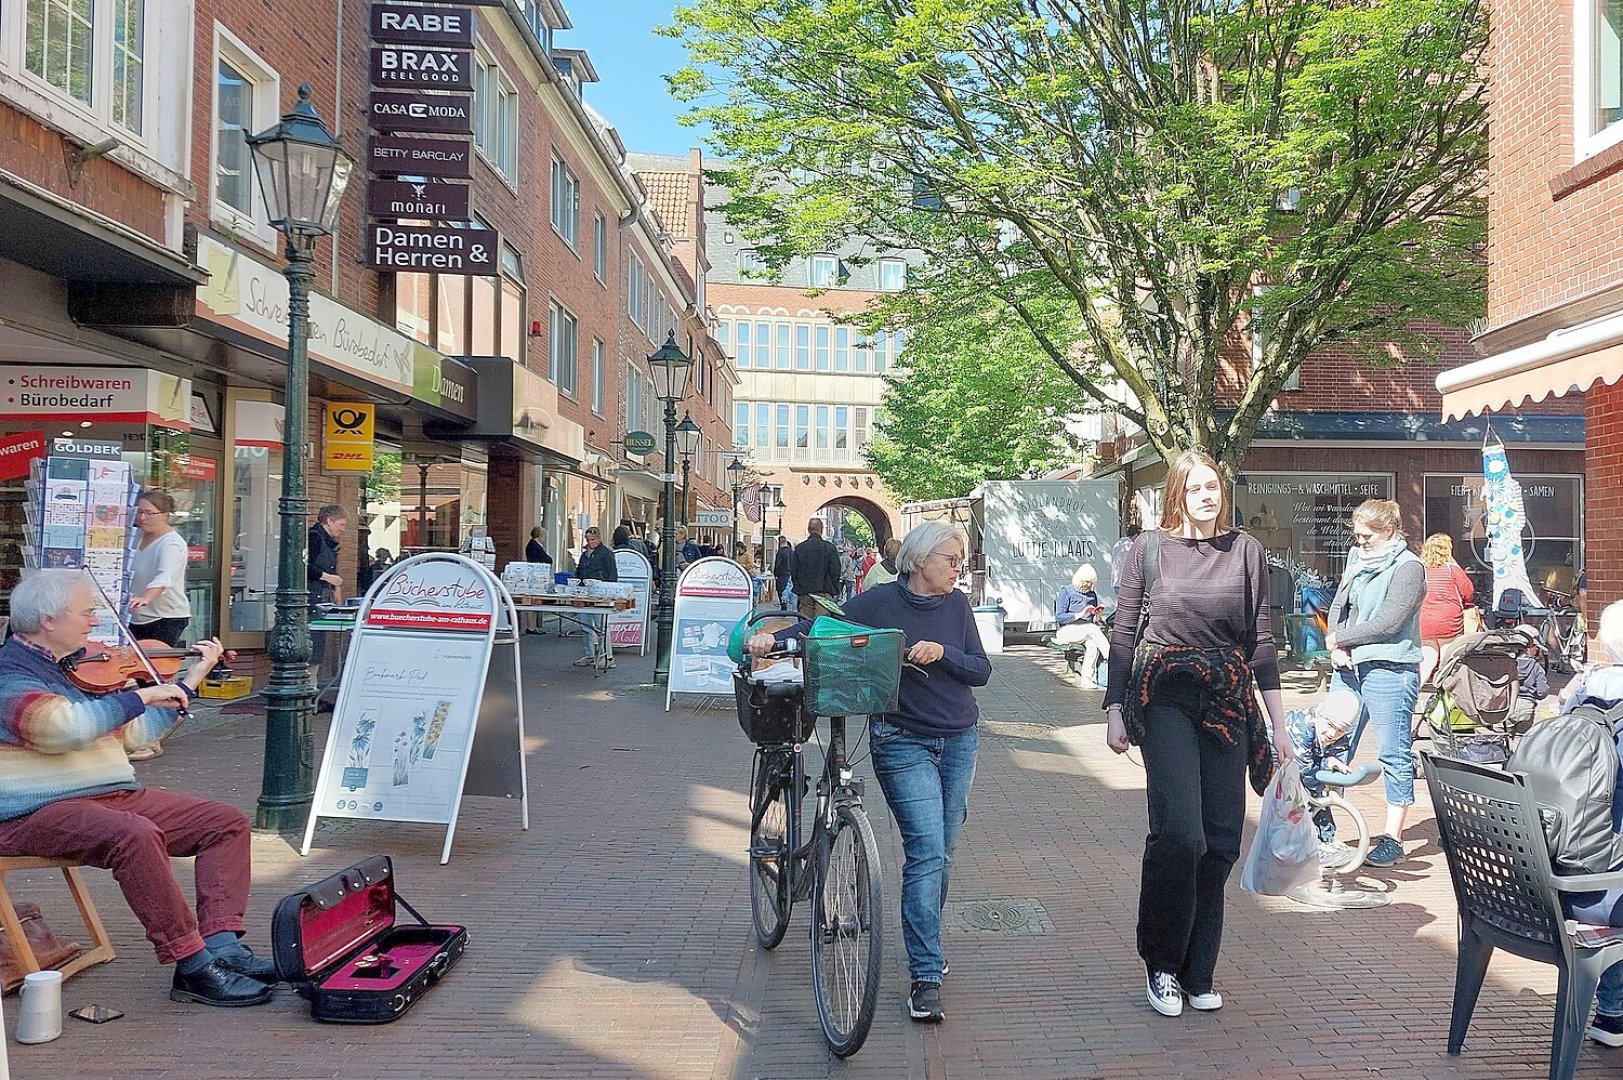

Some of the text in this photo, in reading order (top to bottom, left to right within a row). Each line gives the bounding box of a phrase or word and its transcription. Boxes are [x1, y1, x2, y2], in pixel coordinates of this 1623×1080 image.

[381, 12, 461, 33] RABE
[381, 51, 459, 72] BRAX
[381, 71, 459, 82] FEEL GOOD
[373, 103, 466, 118] CASA MODA
[373, 147, 464, 162] BETTY BARCLAY
[391, 201, 446, 214] monari
[376, 227, 489, 264] Damen &
[375, 247, 462, 268] Herren
[333, 318, 390, 369] Bürobedarf
[20, 374, 131, 390] Schreibwaren
[431, 365, 464, 404] Damen
[20, 393, 114, 408] Bürobedarf
[54, 443, 120, 455] GOLDBEK
[1305, 484, 1352, 495] WASCHMITTEL
[1360, 484, 1379, 495] SEIFE
[1529, 486, 1555, 497] SAMEN
[1054, 540, 1093, 558] PLAATS
[386, 573, 485, 599] Bücherstube
